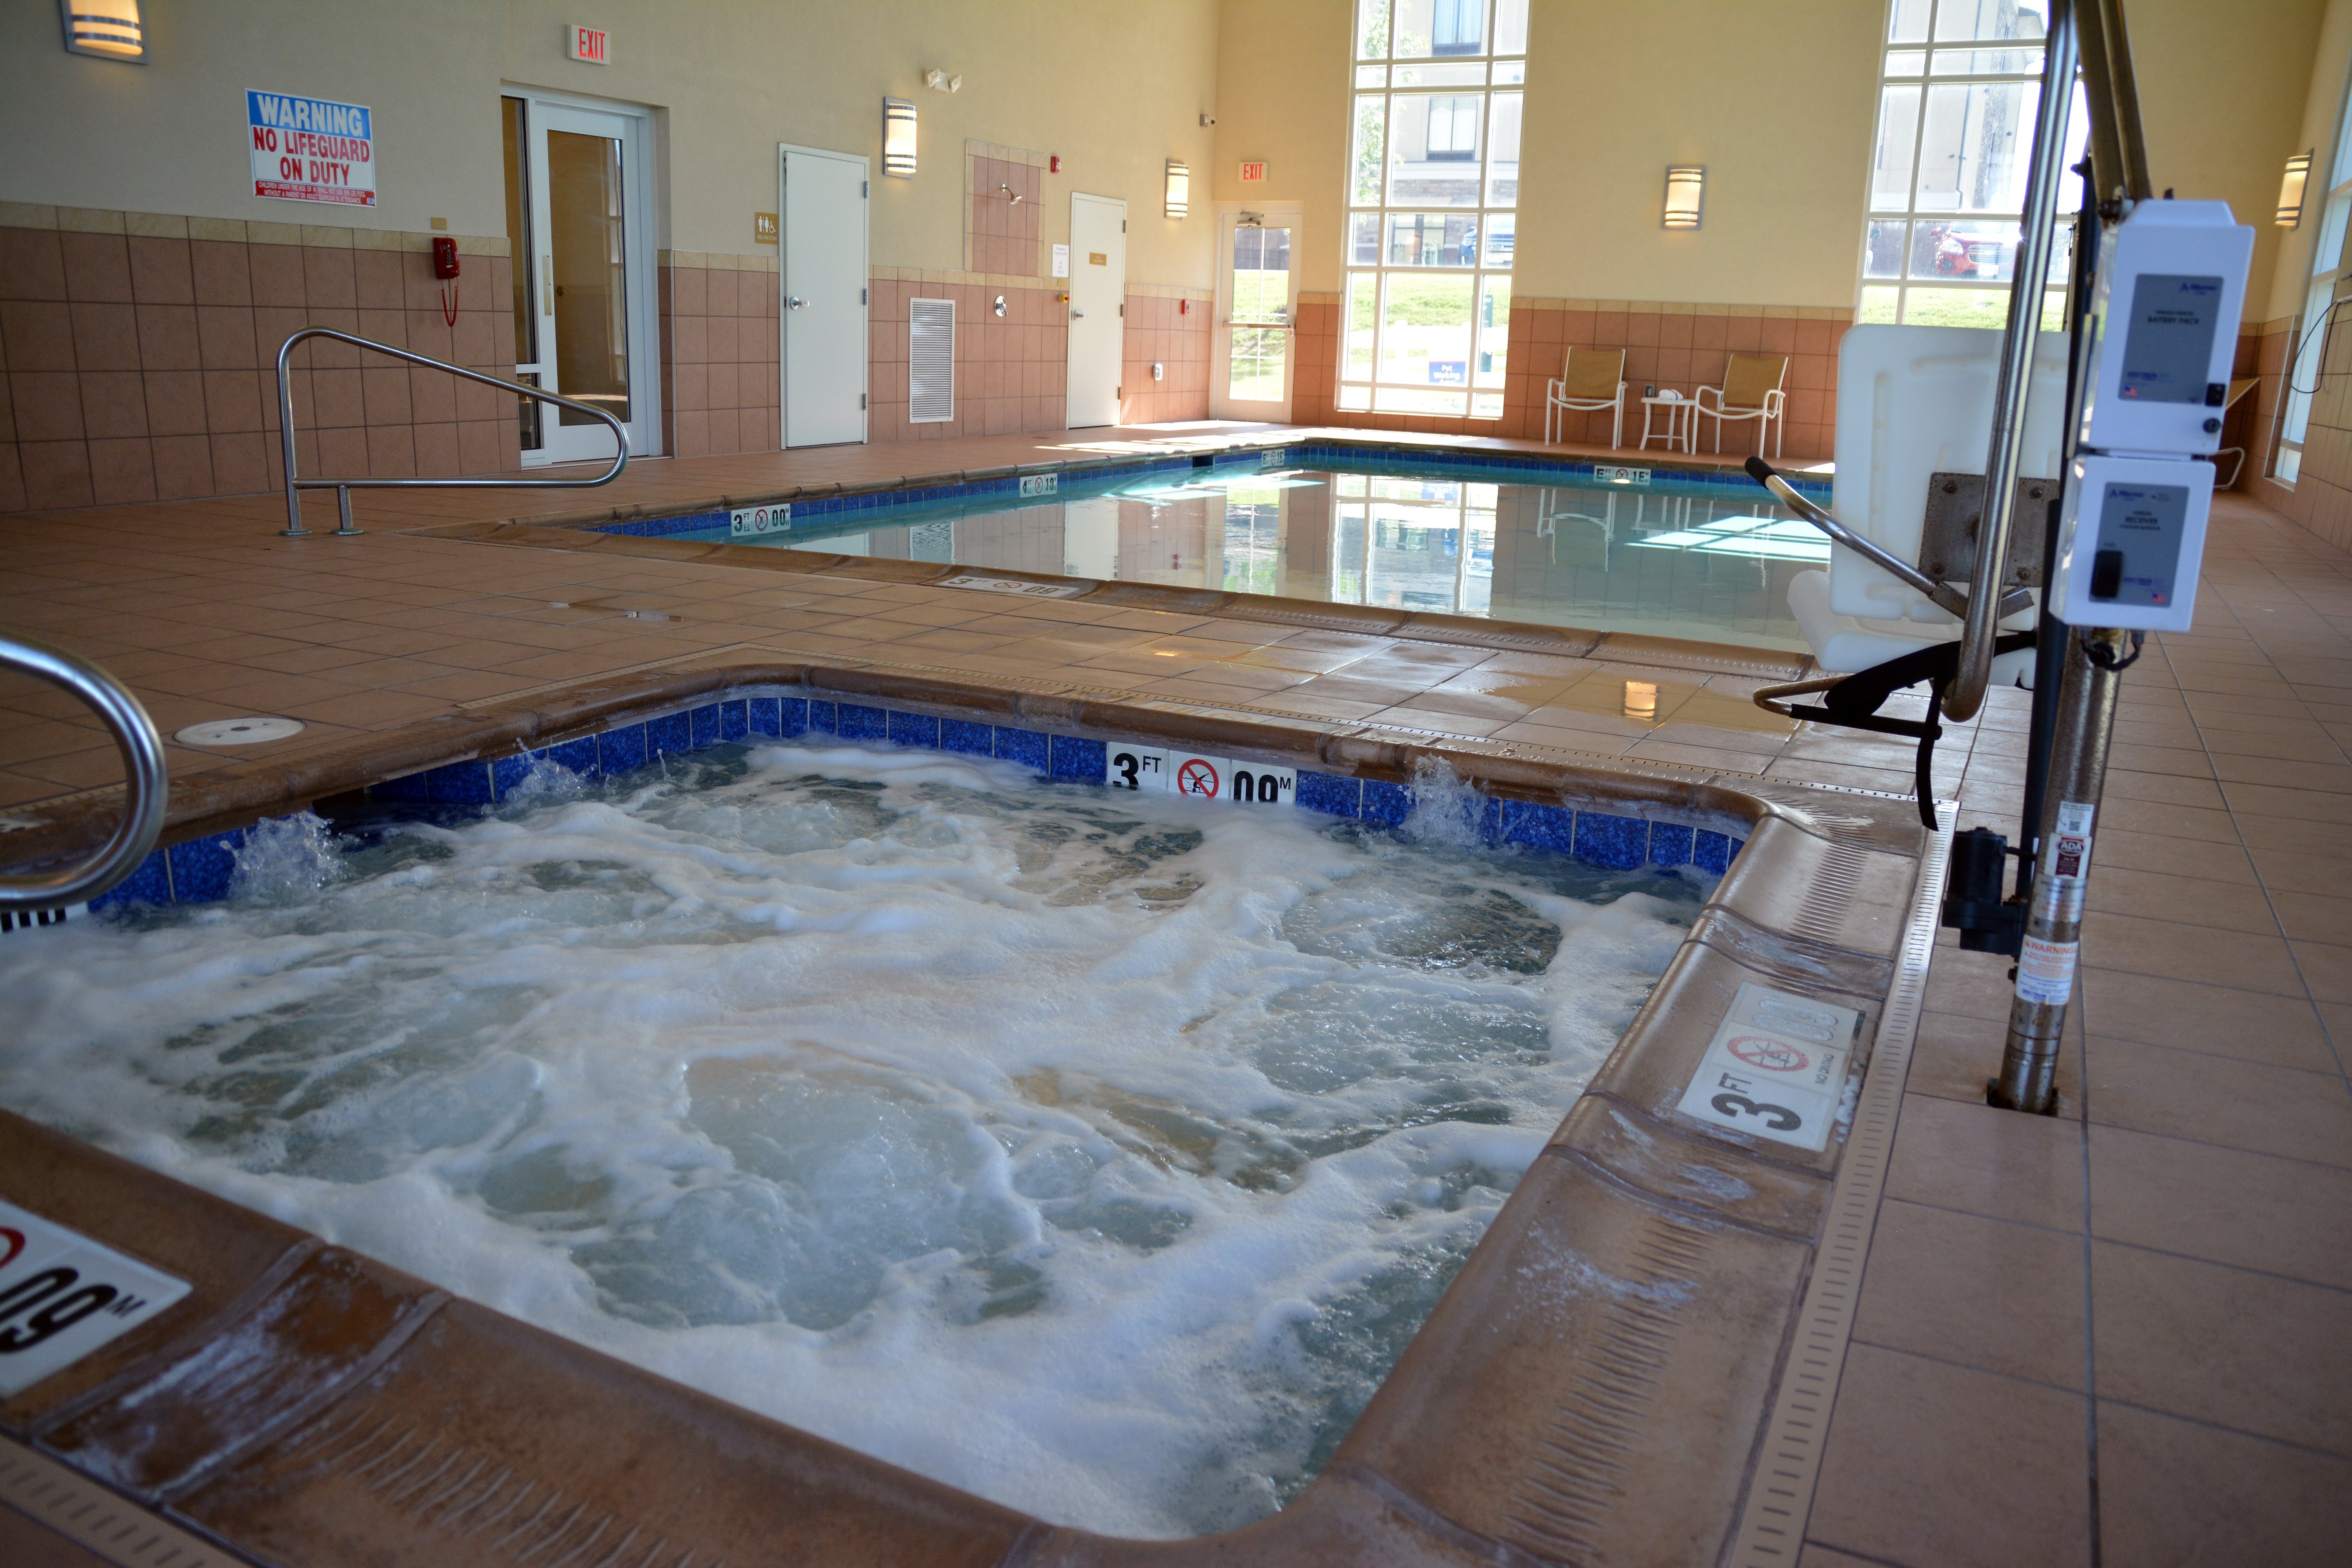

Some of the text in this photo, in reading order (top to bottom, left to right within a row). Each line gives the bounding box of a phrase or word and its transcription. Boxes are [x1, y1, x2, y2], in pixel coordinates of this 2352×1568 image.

[579, 28, 605, 60] EXIT
[257, 94, 363, 136] WARNING
[253, 127, 370, 162] NO LIFEGUARD
[280, 157, 350, 186] ON DUTY
[1243, 163, 1263, 180] EXIT
[1434, 372, 1461, 380] Walking
[1113, 753, 1139, 790] 3
[1143, 756, 1161, 773] FT
[1280, 777, 1291, 790] M
[2060, 841, 2082, 850] ADA
[2031, 941, 2074, 954] WARNING
[1719, 1073, 1752, 1094] FT
[1815, 1053, 1834, 1085] NO DIVING
[1711, 1093, 1801, 1131] 3
